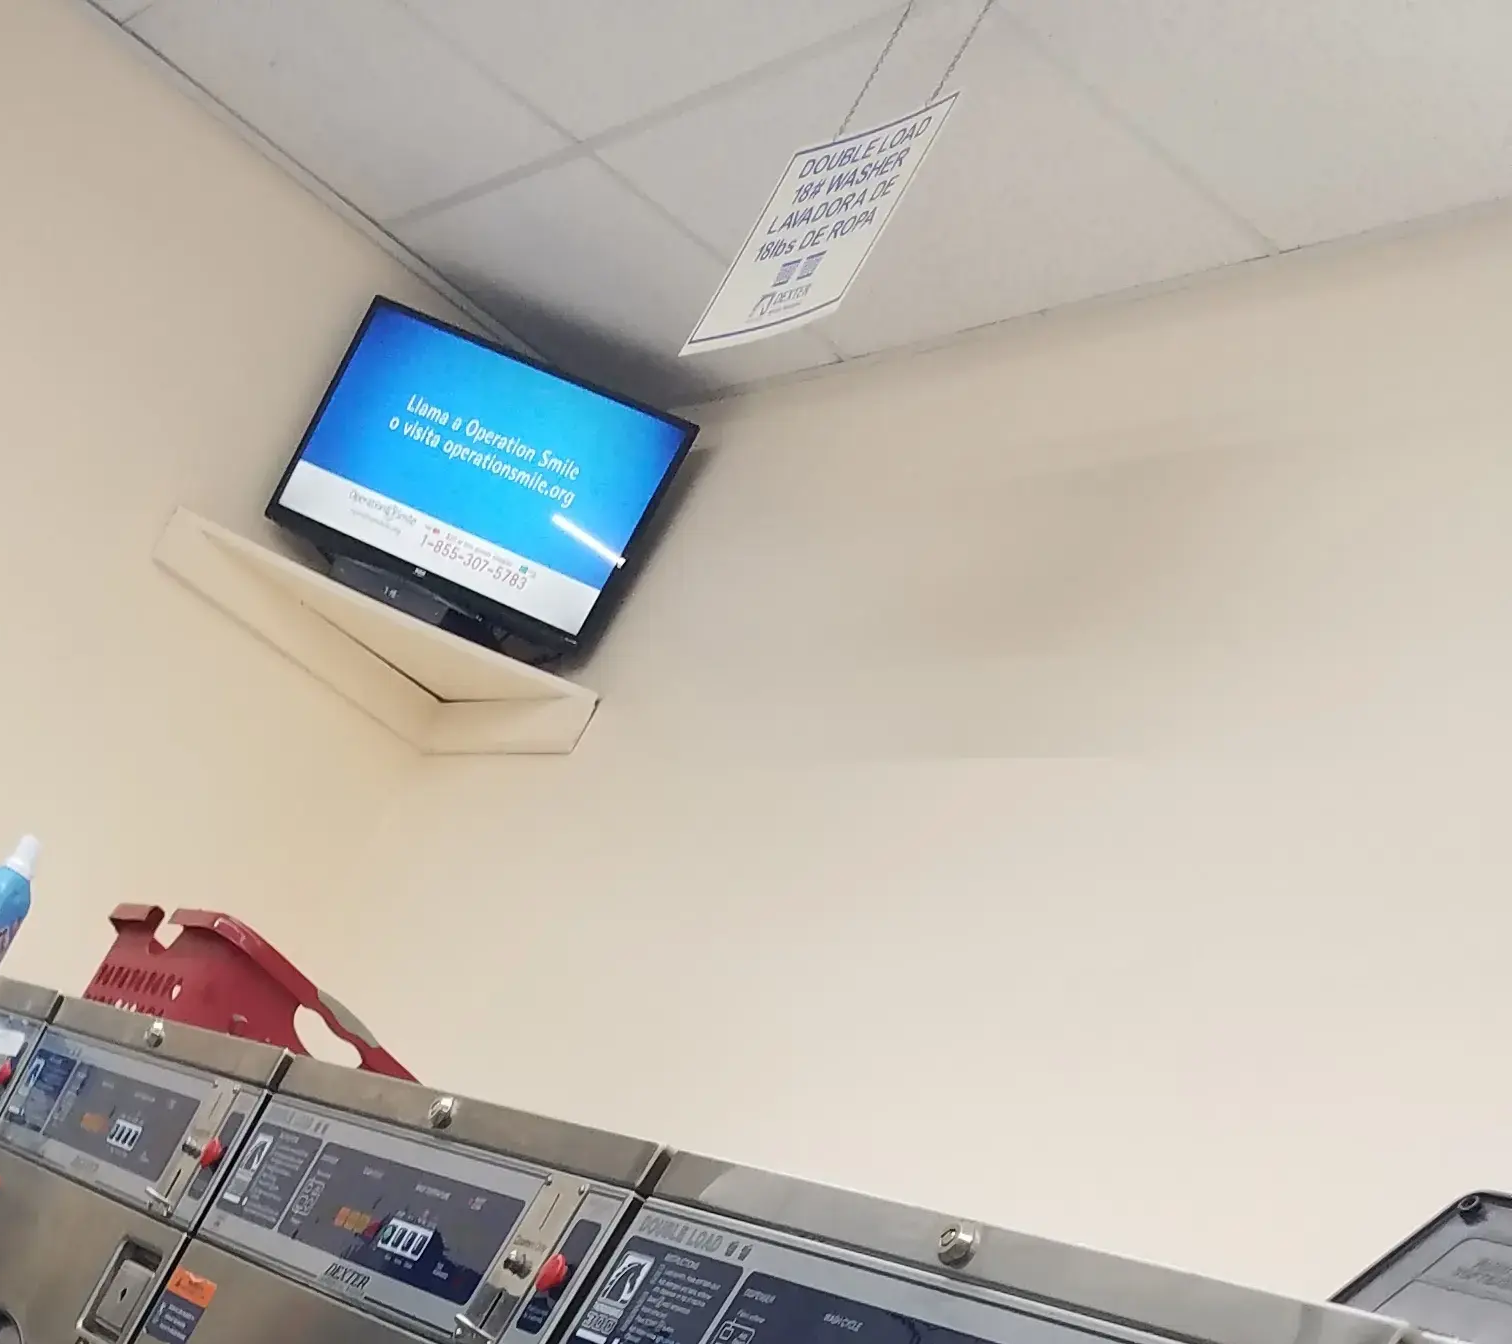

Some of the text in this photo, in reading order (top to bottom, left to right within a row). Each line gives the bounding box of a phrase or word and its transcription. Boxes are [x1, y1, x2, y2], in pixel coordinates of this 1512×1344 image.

[792, 147, 911, 205] 18# WASHER
[798, 116, 933, 179] DOUBLE LOAD
[767, 174, 900, 235] LAVADORA DE
[754, 206, 878, 262] 18lbs DE ROPA
[388, 416, 577, 509] o visita operationsmile.org
[406, 394, 581, 481] Llama a Operation Smile
[419, 533, 528, 591] 1-855-307-5783
[325, 1262, 371, 1290] DEXTER
[581, 1309, 619, 1334] 300
